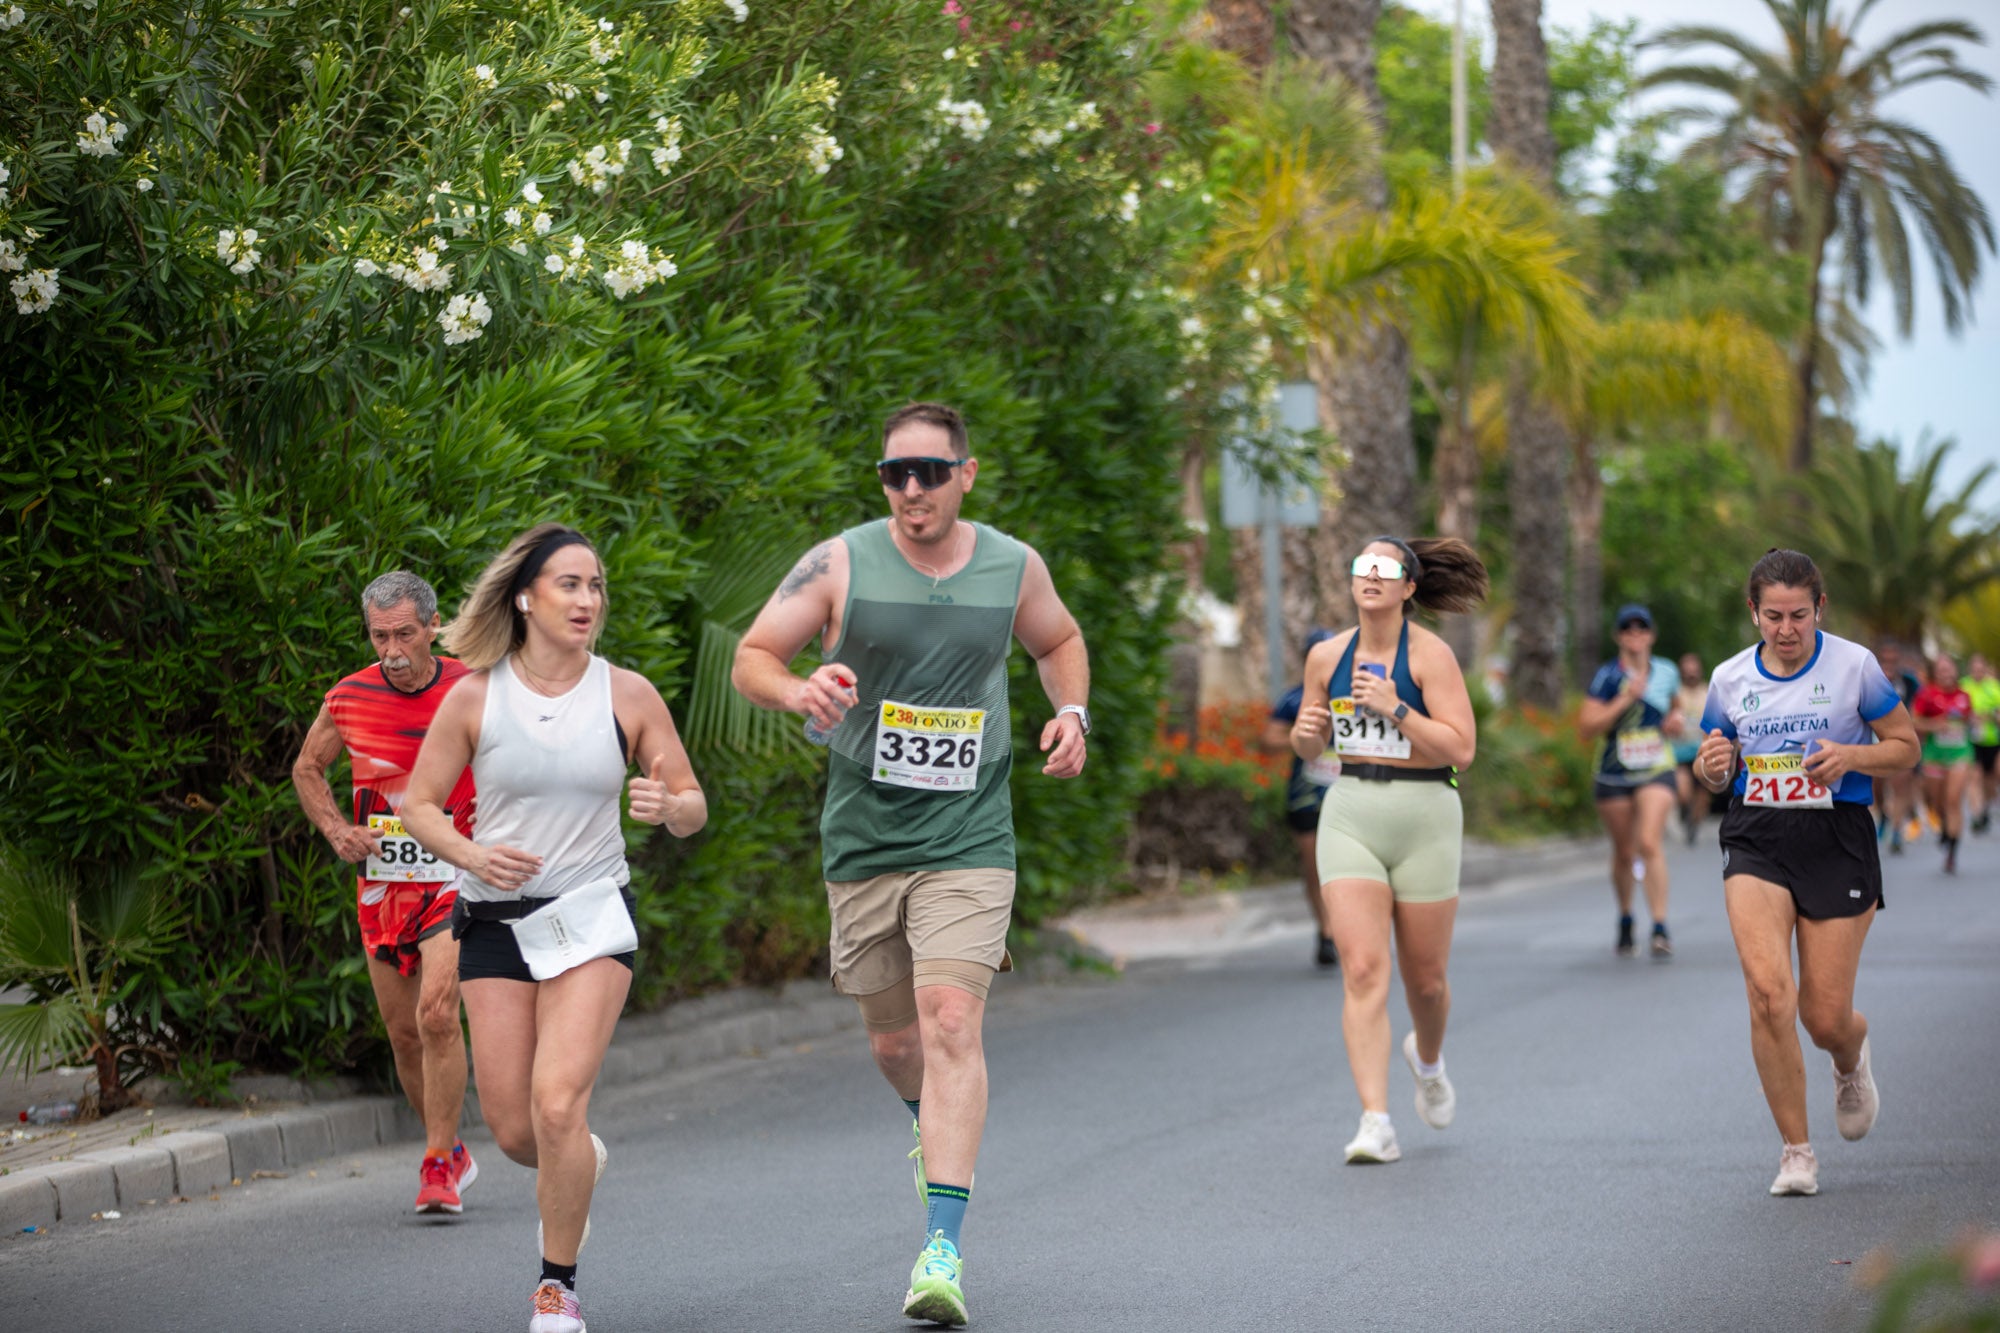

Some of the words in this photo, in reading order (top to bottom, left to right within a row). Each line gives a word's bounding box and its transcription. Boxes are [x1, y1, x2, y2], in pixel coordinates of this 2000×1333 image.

[928, 594, 954, 604] FILA
[896, 709, 914, 724] 38
[913, 716, 966, 729] FONDO
[1748, 718, 1829, 737] MARACENA
[880, 732, 977, 768] 3326
[1747, 776, 1827, 803] 2128
